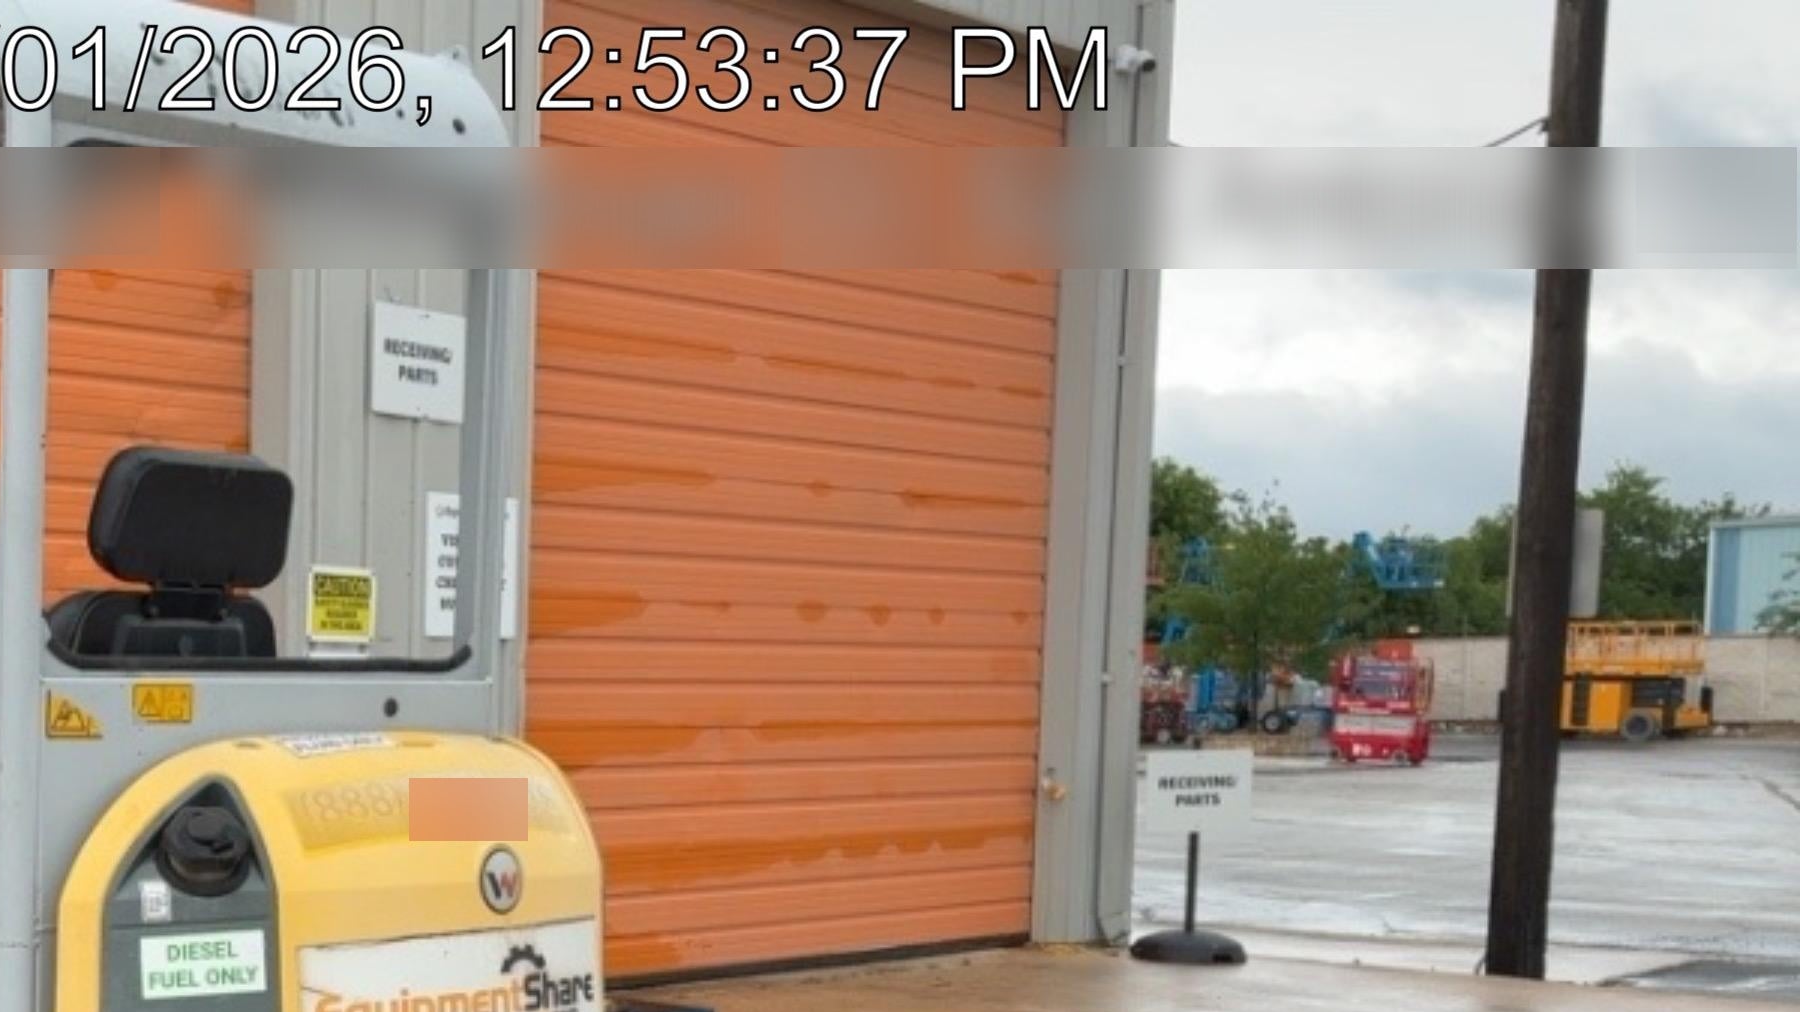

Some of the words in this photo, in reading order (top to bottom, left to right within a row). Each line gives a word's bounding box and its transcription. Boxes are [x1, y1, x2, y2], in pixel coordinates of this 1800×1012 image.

[398, 364, 439, 386] PARTS
[1175, 793, 1221, 807] PARTS
[167, 941, 240, 962] DIESEL
[149, 967, 200, 990] FUEL
[205, 965, 259, 986] ONLY
